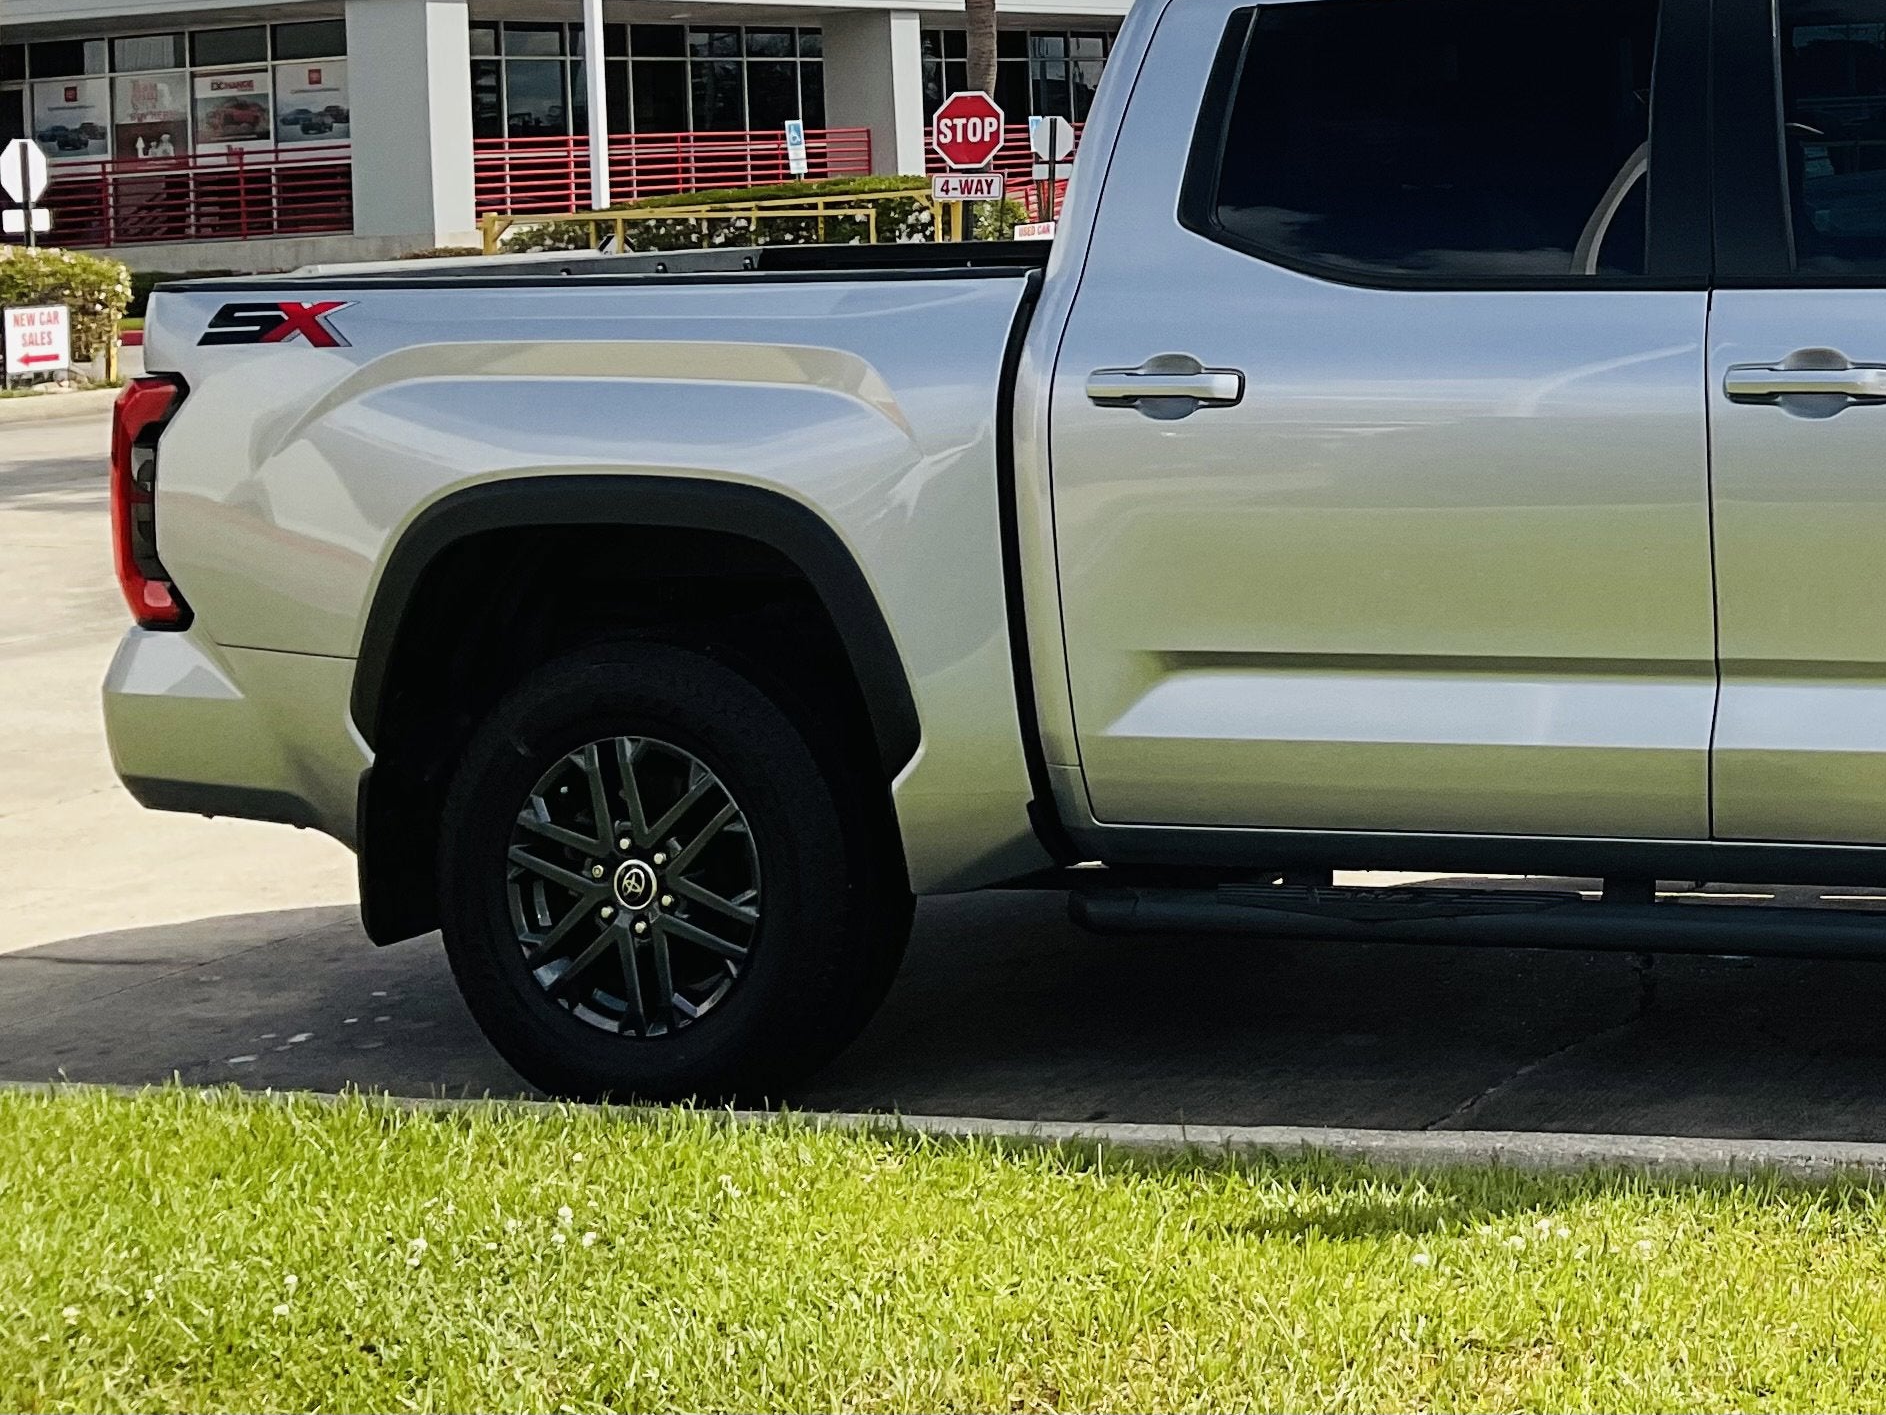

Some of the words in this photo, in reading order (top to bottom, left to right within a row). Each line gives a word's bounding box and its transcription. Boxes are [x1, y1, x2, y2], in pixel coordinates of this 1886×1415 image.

[939, 117, 998, 143] STOP
[940, 179, 994, 195] 4-WAY
[1019, 226, 1035, 237] USED
[13, 313, 35, 327] NEW
[39, 311, 59, 325] CAR
[22, 331, 53, 347] SALES
